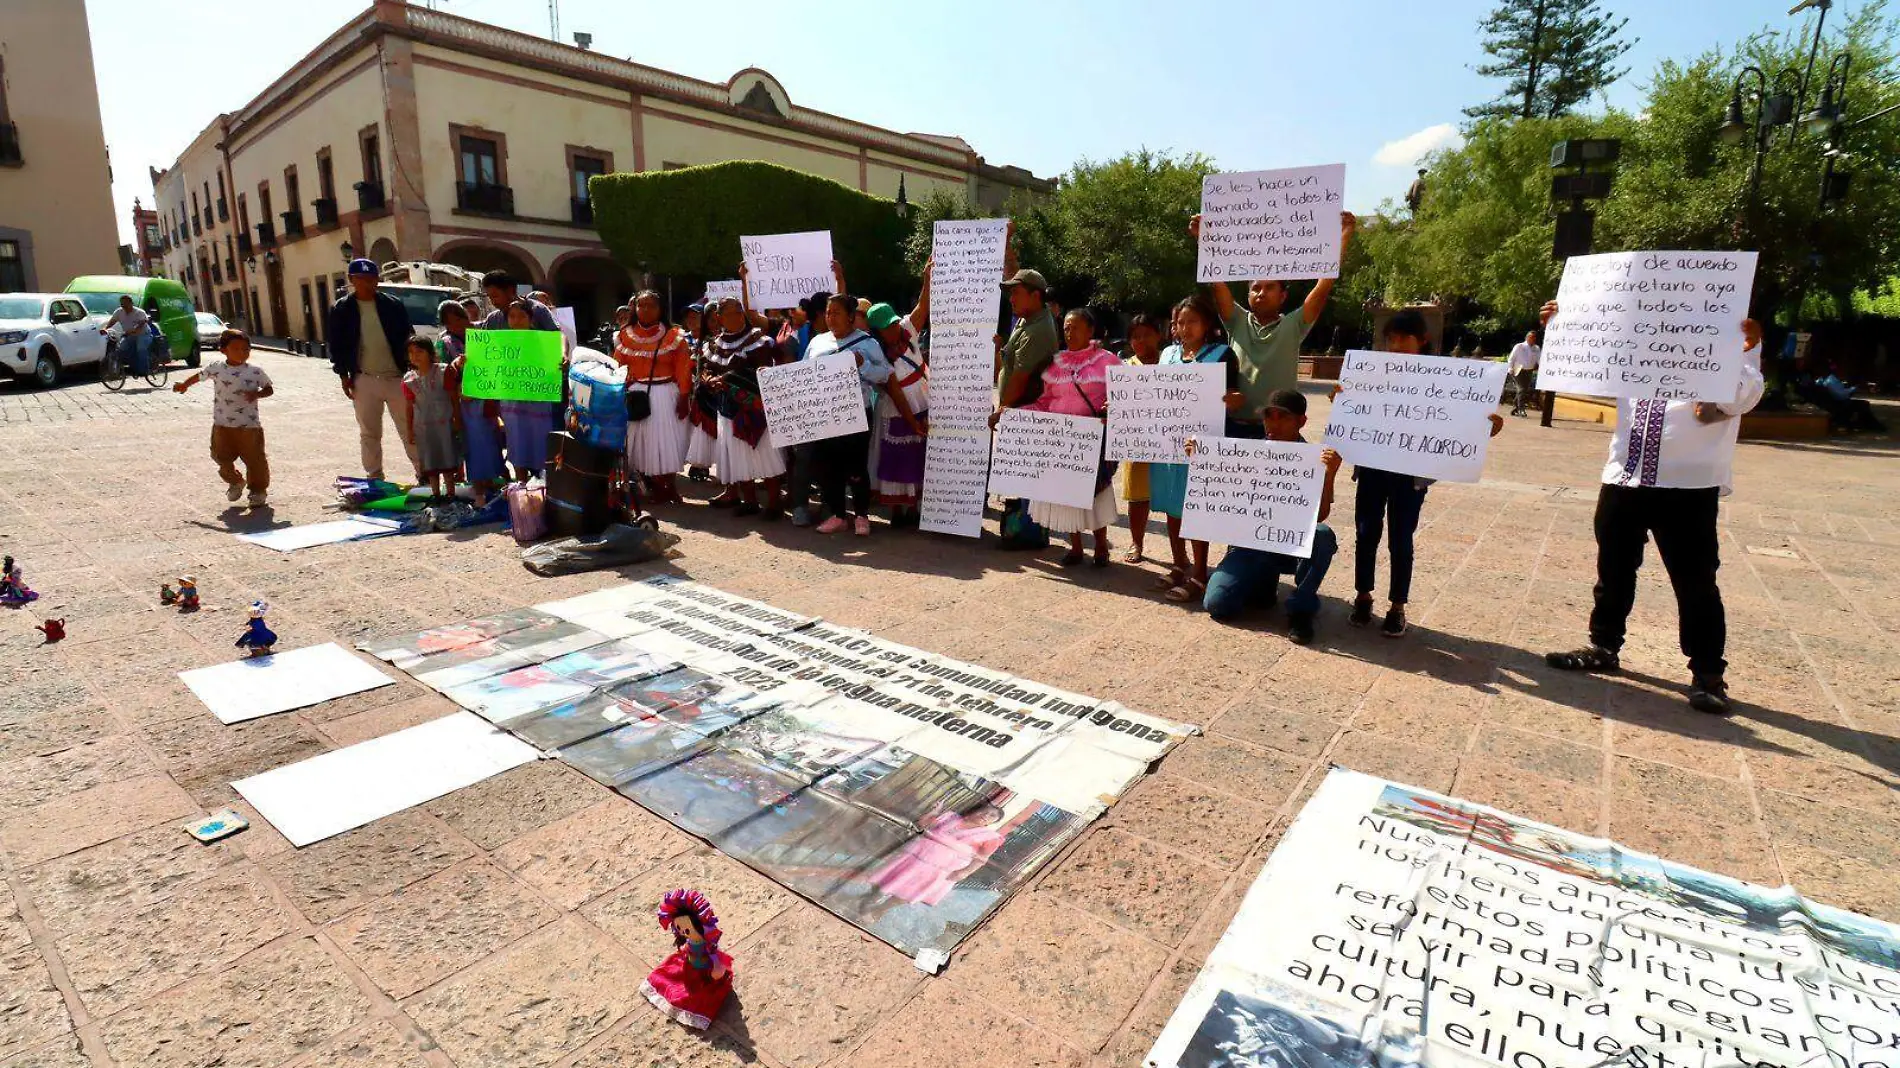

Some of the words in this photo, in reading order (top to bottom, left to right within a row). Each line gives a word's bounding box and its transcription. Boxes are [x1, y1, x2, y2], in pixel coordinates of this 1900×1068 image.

[1204, 179, 1226, 196] Se
[1230, 180, 1253, 192] les
[1258, 177, 1294, 190] hace
[1299, 175, 1318, 186] un
[1204, 198, 1259, 213] llamado
[1267, 200, 1278, 209] a
[1285, 192, 1321, 206] todos
[1204, 212, 1284, 228] involucrados
[1290, 210, 1314, 223] del
[1237, 227, 1294, 243] proyecto
[1297, 225, 1318, 237] del
[756, 255, 795, 273] ESTOY
[1643, 254, 1672, 271] de
[1677, 257, 1738, 271] acuerdo
[750, 278, 768, 298] DE
[1604, 279, 1696, 294] secretario
[1704, 283, 1737, 299] aya
[1596, 302, 1627, 318] que
[1637, 300, 1694, 313] todos
[1703, 300, 1731, 315] los
[1633, 321, 1720, 336] estamos
[485, 346, 521, 361] ESTOY
[1648, 342, 1687, 355] con
[1694, 343, 1713, 358] el
[473, 366, 489, 378] DE
[1347, 353, 1376, 371] Las
[1385, 361, 1453, 376] palabras
[1457, 367, 1484, 380] del
[1607, 353, 1634, 368] del
[1639, 356, 1723, 373] mercado
[1137, 369, 1204, 383] artesanos
[1659, 375, 1687, 386] es
[1111, 390, 1128, 401] NO
[1134, 387, 1199, 402] ESTAMOS
[1342, 376, 1420, 396] Secretario
[1424, 383, 1445, 398] de
[1450, 386, 1497, 404] estado
[1048, 427, 1064, 438] del
[1148, 424, 1158, 434] el
[1161, 421, 1209, 437] proyecto
[1349, 426, 1394, 446] ESTOY
[1399, 433, 1417, 452] DE
[1015, 437, 1030, 446] del
[1217, 442, 1250, 457] todos
[1253, 449, 1303, 461] estamos
[1034, 459, 1050, 468] del
[1190, 460, 1259, 475] satisfechos
[1264, 467, 1299, 478] sobre
[1303, 468, 1314, 479] el
[1190, 475, 1243, 487] espacio
[1250, 479, 1274, 491] que
[1277, 482, 1301, 491] nos
[1188, 487, 1226, 498] estan
[1232, 490, 1310, 507] imponiendo
[1184, 501, 1200, 511] en
[1205, 501, 1215, 512] la
[1219, 505, 1248, 515] casa
[1253, 507, 1273, 521] del
[1255, 523, 1306, 548] CEDAI
[876, 651, 913, 664] su
[721, 665, 787, 692] 2023
[764, 659, 800, 673] de
[894, 699, 1014, 749] materna
[891, 674, 926, 689] 21
[917, 682, 955, 701] de
[952, 692, 1054, 731] febrero
[1357, 838, 1430, 870] nos
[1357, 814, 1541, 886] Nuestros
[1556, 880, 1803, 957] ancestros
[1334, 881, 1620, 994] reformadas,
[1425, 884, 1546, 937] estos
[1564, 929, 1795, 1015] políticos
[1311, 933, 1492, 1018] cultura,
[1345, 913, 1477, 969] servir
[1492, 965, 1611, 1018] para
[1286, 958, 1424, 1018] ahora
